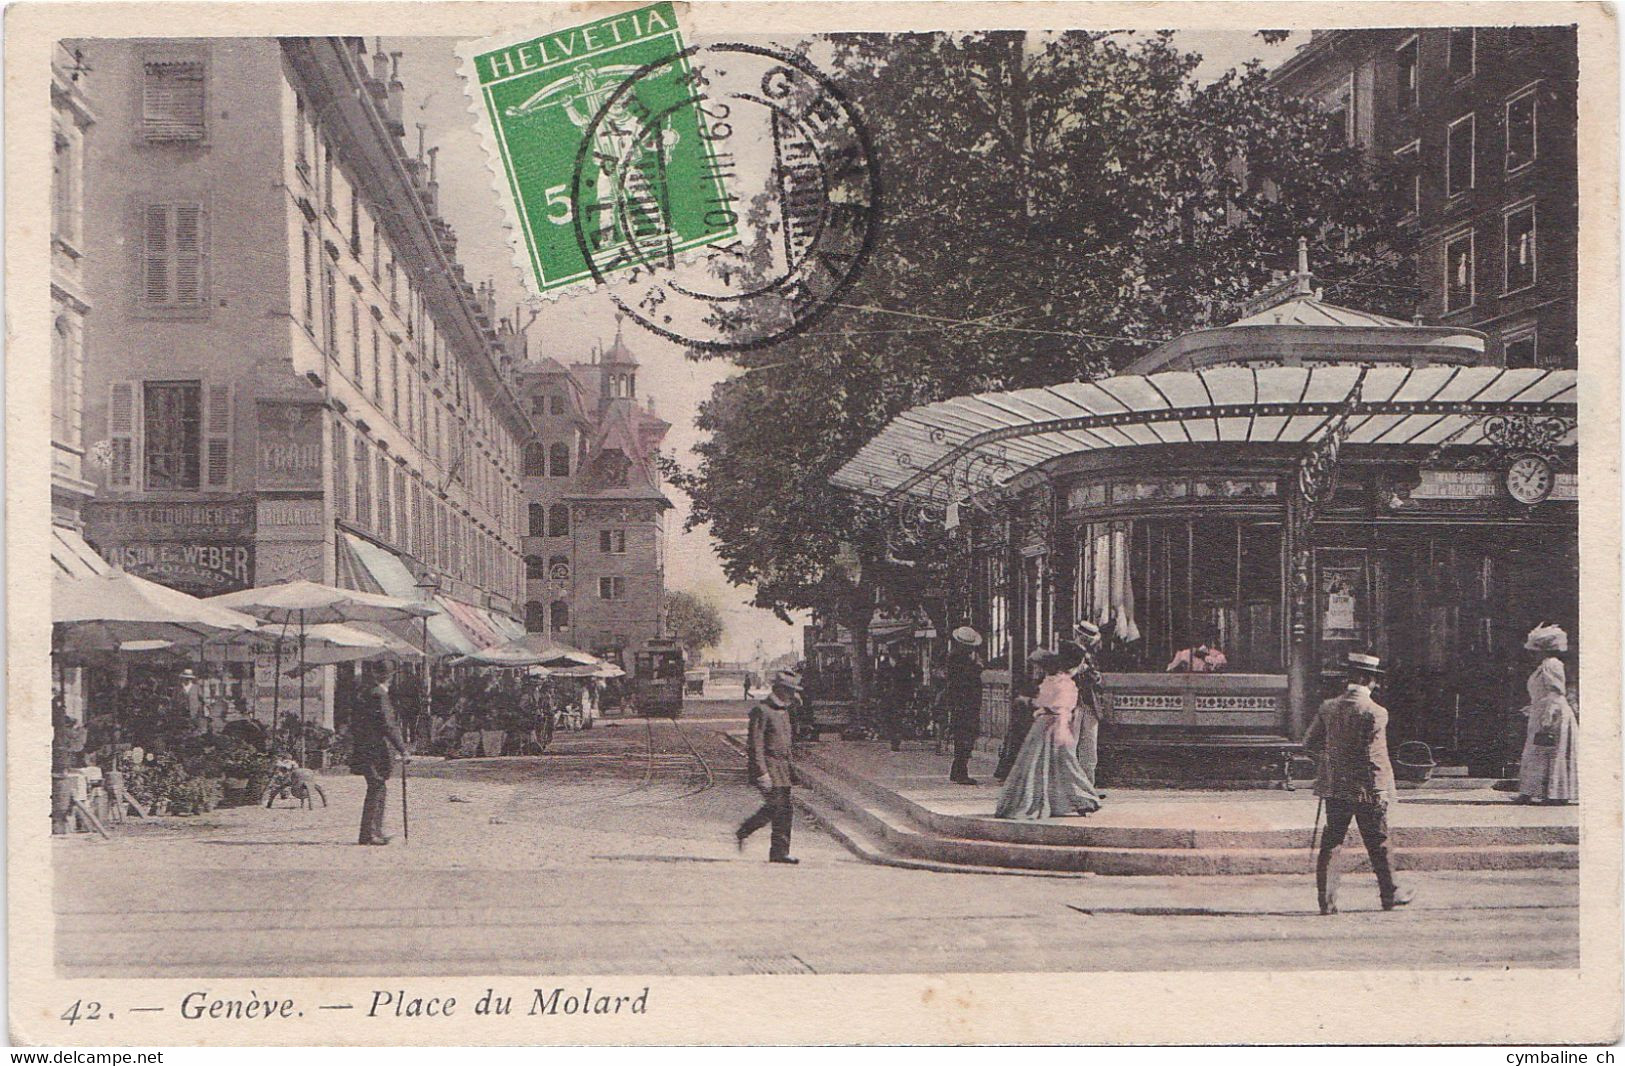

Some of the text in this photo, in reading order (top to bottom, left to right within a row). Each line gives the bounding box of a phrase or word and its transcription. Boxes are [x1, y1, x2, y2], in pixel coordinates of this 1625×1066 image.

[489, 7, 671, 78] HELVETIA
[545, 184, 573, 225] 5
[183, 545, 250, 585] WEBER
